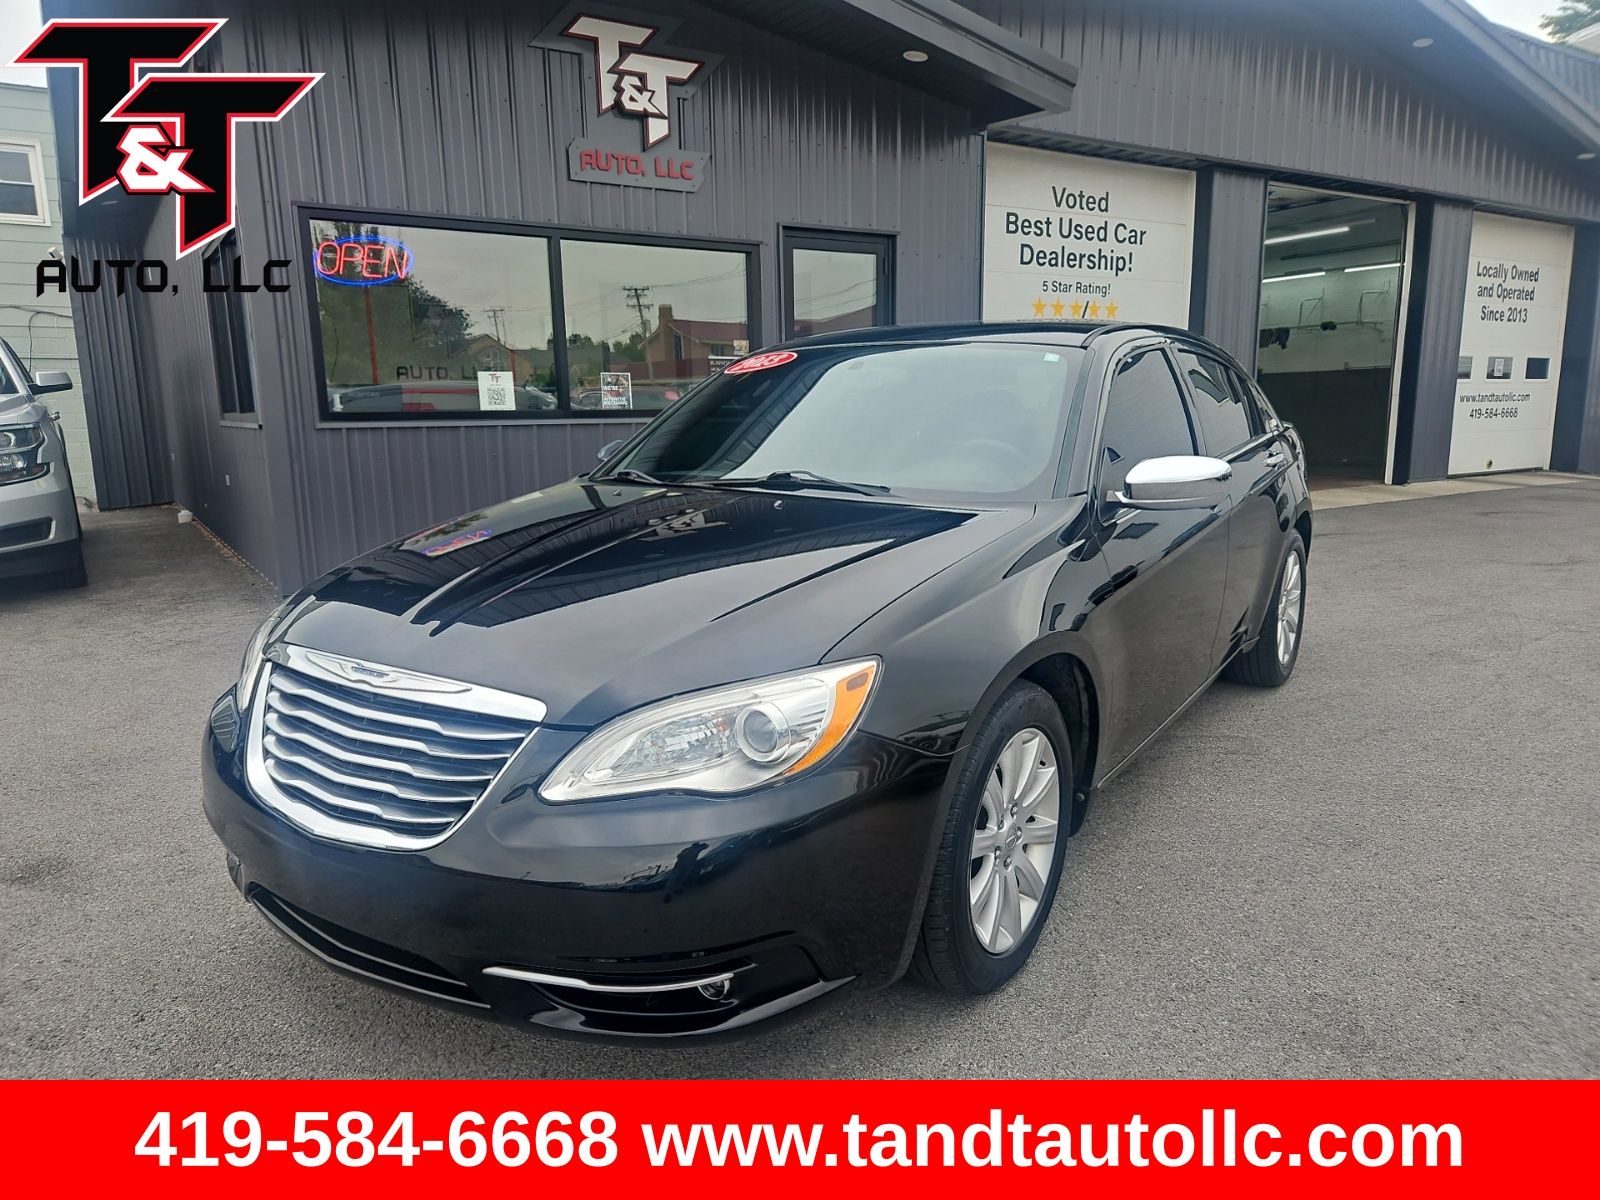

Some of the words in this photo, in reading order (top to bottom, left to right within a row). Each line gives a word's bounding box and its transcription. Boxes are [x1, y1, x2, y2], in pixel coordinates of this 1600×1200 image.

[654, 156, 696, 181] LLC
[1052, 186, 1109, 213] Voted
[1005, 212, 1052, 238] Best
[1058, 217, 1108, 243] Used
[1114, 223, 1147, 245] Car
[317, 241, 409, 280] OPEN
[1019, 243, 1133, 277] Dealership!
[1477, 261, 1509, 283] Locally
[1511, 265, 1540, 283] Owned
[1042, 281, 1049, 292] 5
[1051, 281, 1072, 293] Star
[1075, 282, 1111, 298] Rating!
[1477, 283, 1494, 298] and
[1496, 283, 1536, 303] Operated
[1480, 306, 1505, 322] Since
[1507, 307, 1528, 324] 2013
[1459, 390, 1531, 403] www.tandtautollc.com
[1469, 407, 1519, 419] 419-584-6668
